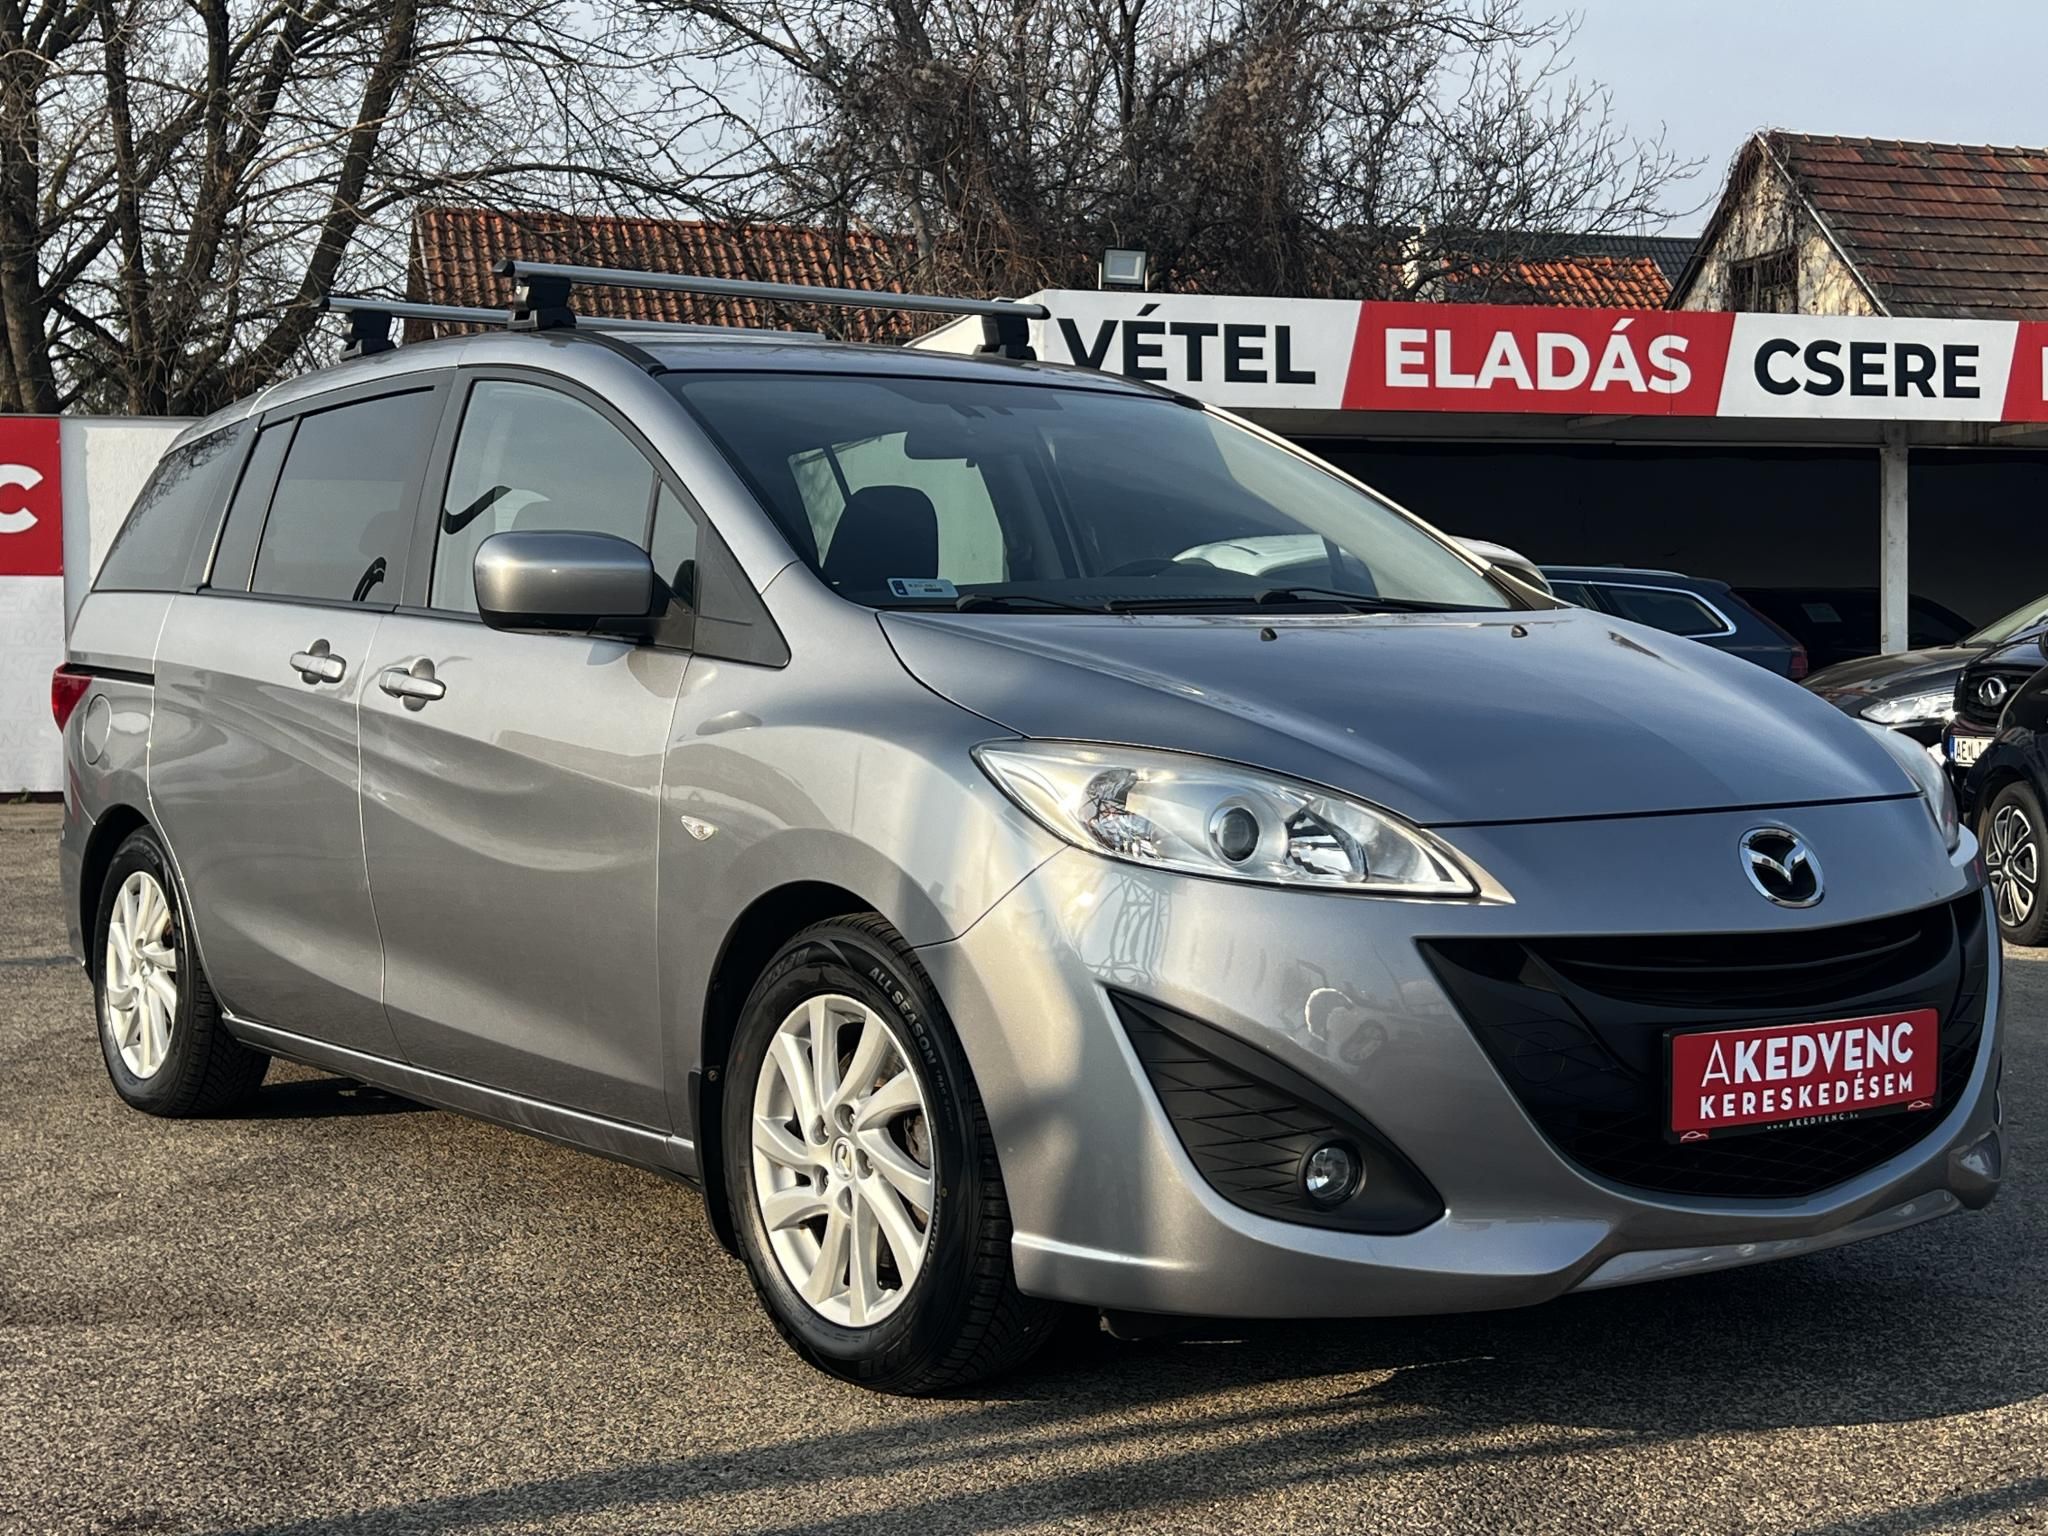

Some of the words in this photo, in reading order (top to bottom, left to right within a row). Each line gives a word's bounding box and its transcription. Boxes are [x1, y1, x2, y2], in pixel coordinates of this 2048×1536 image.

[1057, 303, 1316, 384] VÉTEL
[1385, 318, 1692, 394] ELADÁS
[1754, 338, 1981, 399] CSERE
[868, 967, 893, 993] ALL
[891, 990, 937, 1065] SEASON
[1701, 1022, 1914, 1088] AKEDVENC
[1700, 1071, 1913, 1119] KERESKEDÉSEM
